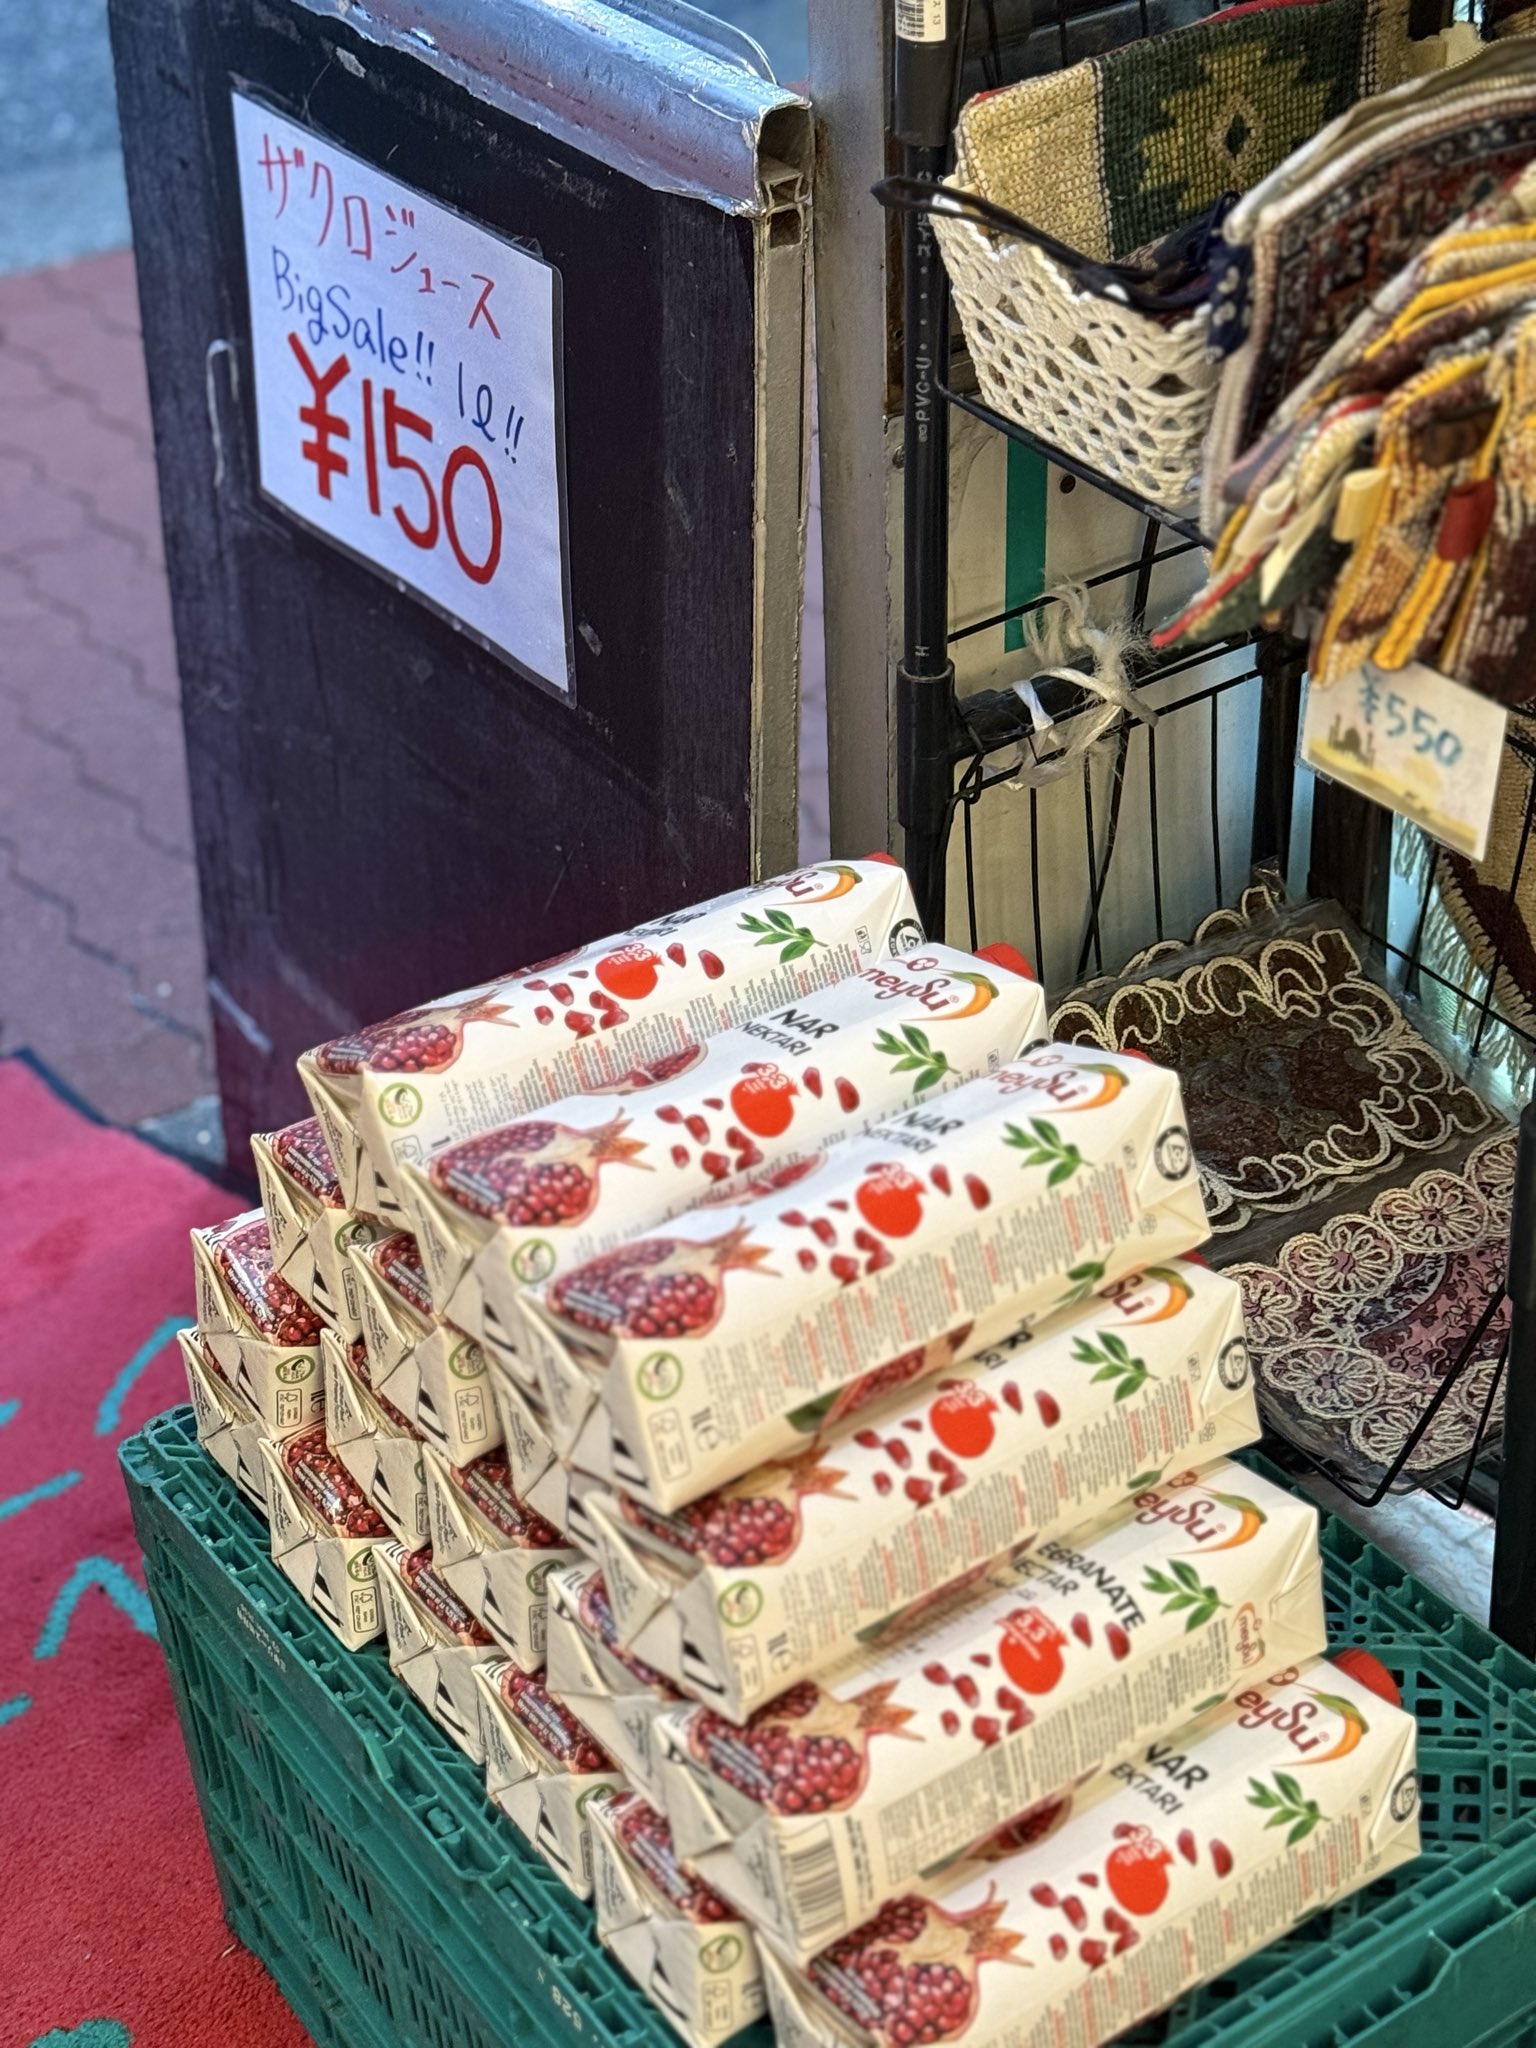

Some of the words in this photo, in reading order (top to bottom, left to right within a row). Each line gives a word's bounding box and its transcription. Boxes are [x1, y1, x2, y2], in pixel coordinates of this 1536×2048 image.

[257, 133, 501, 341] ザクロジュース
[286, 331, 503, 586] ¥150
[1358, 664, 1464, 768] ¥550
[857, 966, 951, 1013] meySu
[735, 1020, 814, 1057] NEKTARI
[769, 1008, 841, 1040] NAR
[1133, 1490, 1218, 1543] eySu
[1035, 1541, 1147, 1634] EGRANATE
[1233, 1688, 1322, 1754] eySu
[1109, 1761, 1184, 1817] EKTARI
